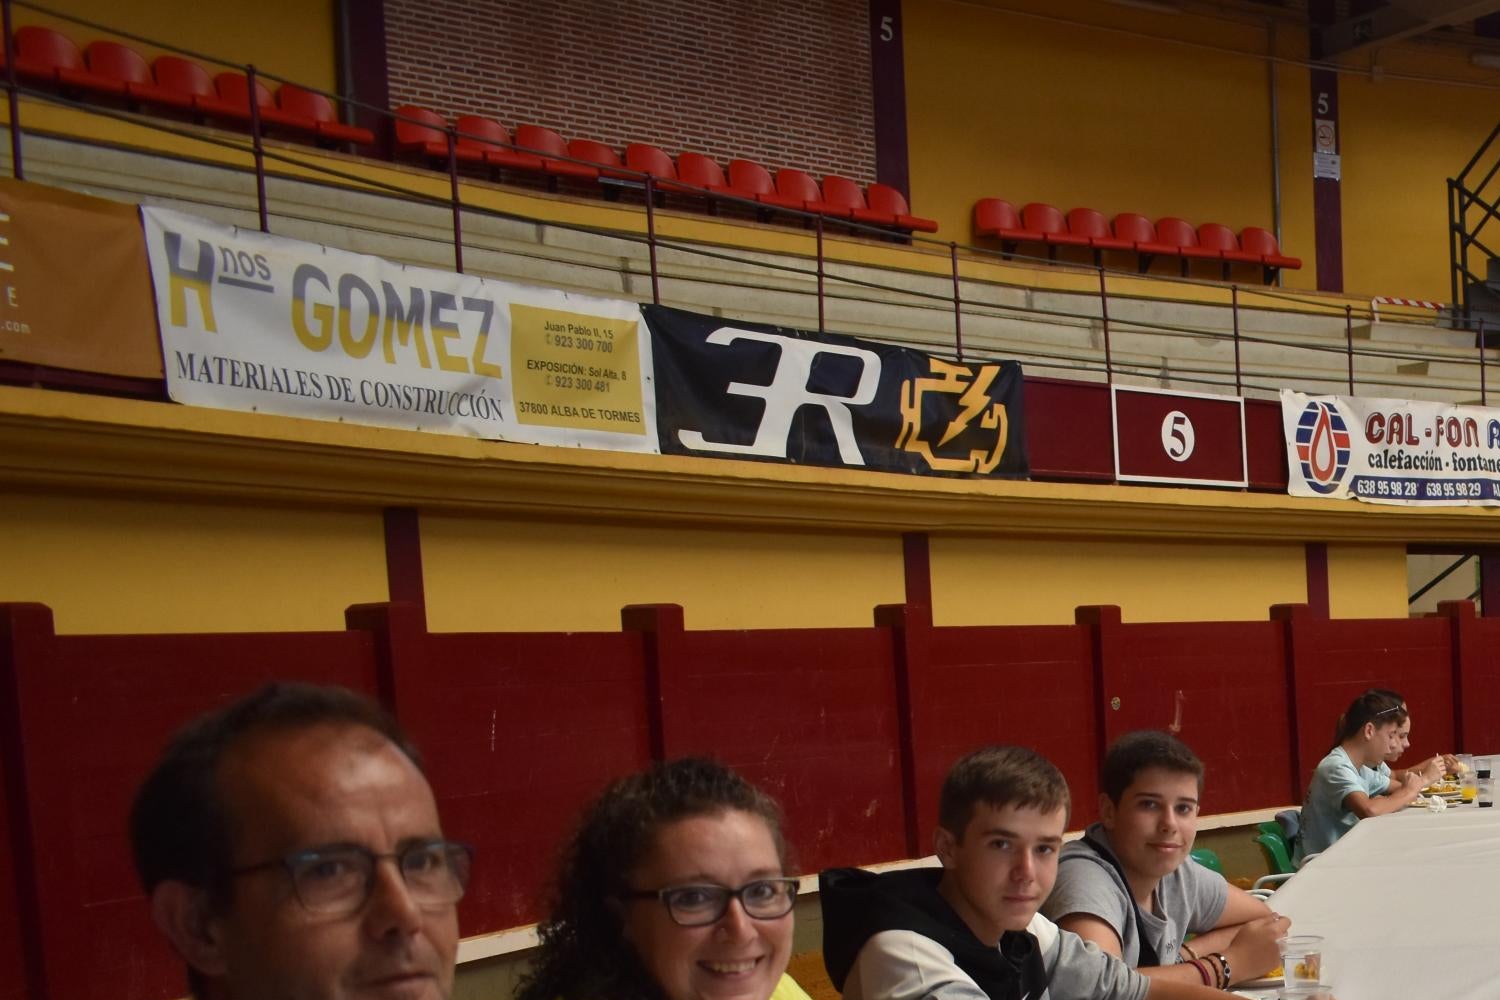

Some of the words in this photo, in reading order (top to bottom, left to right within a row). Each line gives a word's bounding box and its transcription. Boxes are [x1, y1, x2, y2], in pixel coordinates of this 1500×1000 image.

[880, 16, 893, 41] 5
[1318, 93, 1329, 114] 5
[292, 263, 503, 379] GOMEZ
[544, 321, 566, 334] Juan
[568, 325, 591, 337] Pablo
[603, 329, 614, 339] 15
[554, 335, 573, 348] 923
[576, 337, 593, 351] 300
[527, 359, 587, 376] EXPOSICIÓN:
[175, 350, 322, 400] MATERIALES
[324, 374, 355, 403] DE
[360, 379, 504, 422] CONSTRUCCIÓN
[555, 375, 573, 389] 923
[576, 379, 593, 391] 300
[519, 401, 548, 415] 37800
[551, 405, 580, 418] ALBA
[581, 407, 597, 419] DE
[599, 409, 641, 423] TORMES
[1170, 416, 1186, 458] 5
[1368, 449, 1444, 472] calefacción
[1357, 479, 1376, 494] 638
[1377, 480, 1390, 495] 95
[1390, 480, 1402, 495] 98
[1404, 481, 1417, 496] 28
[1426, 482, 1443, 497] 638
[1443, 483, 1455, 497] 95
